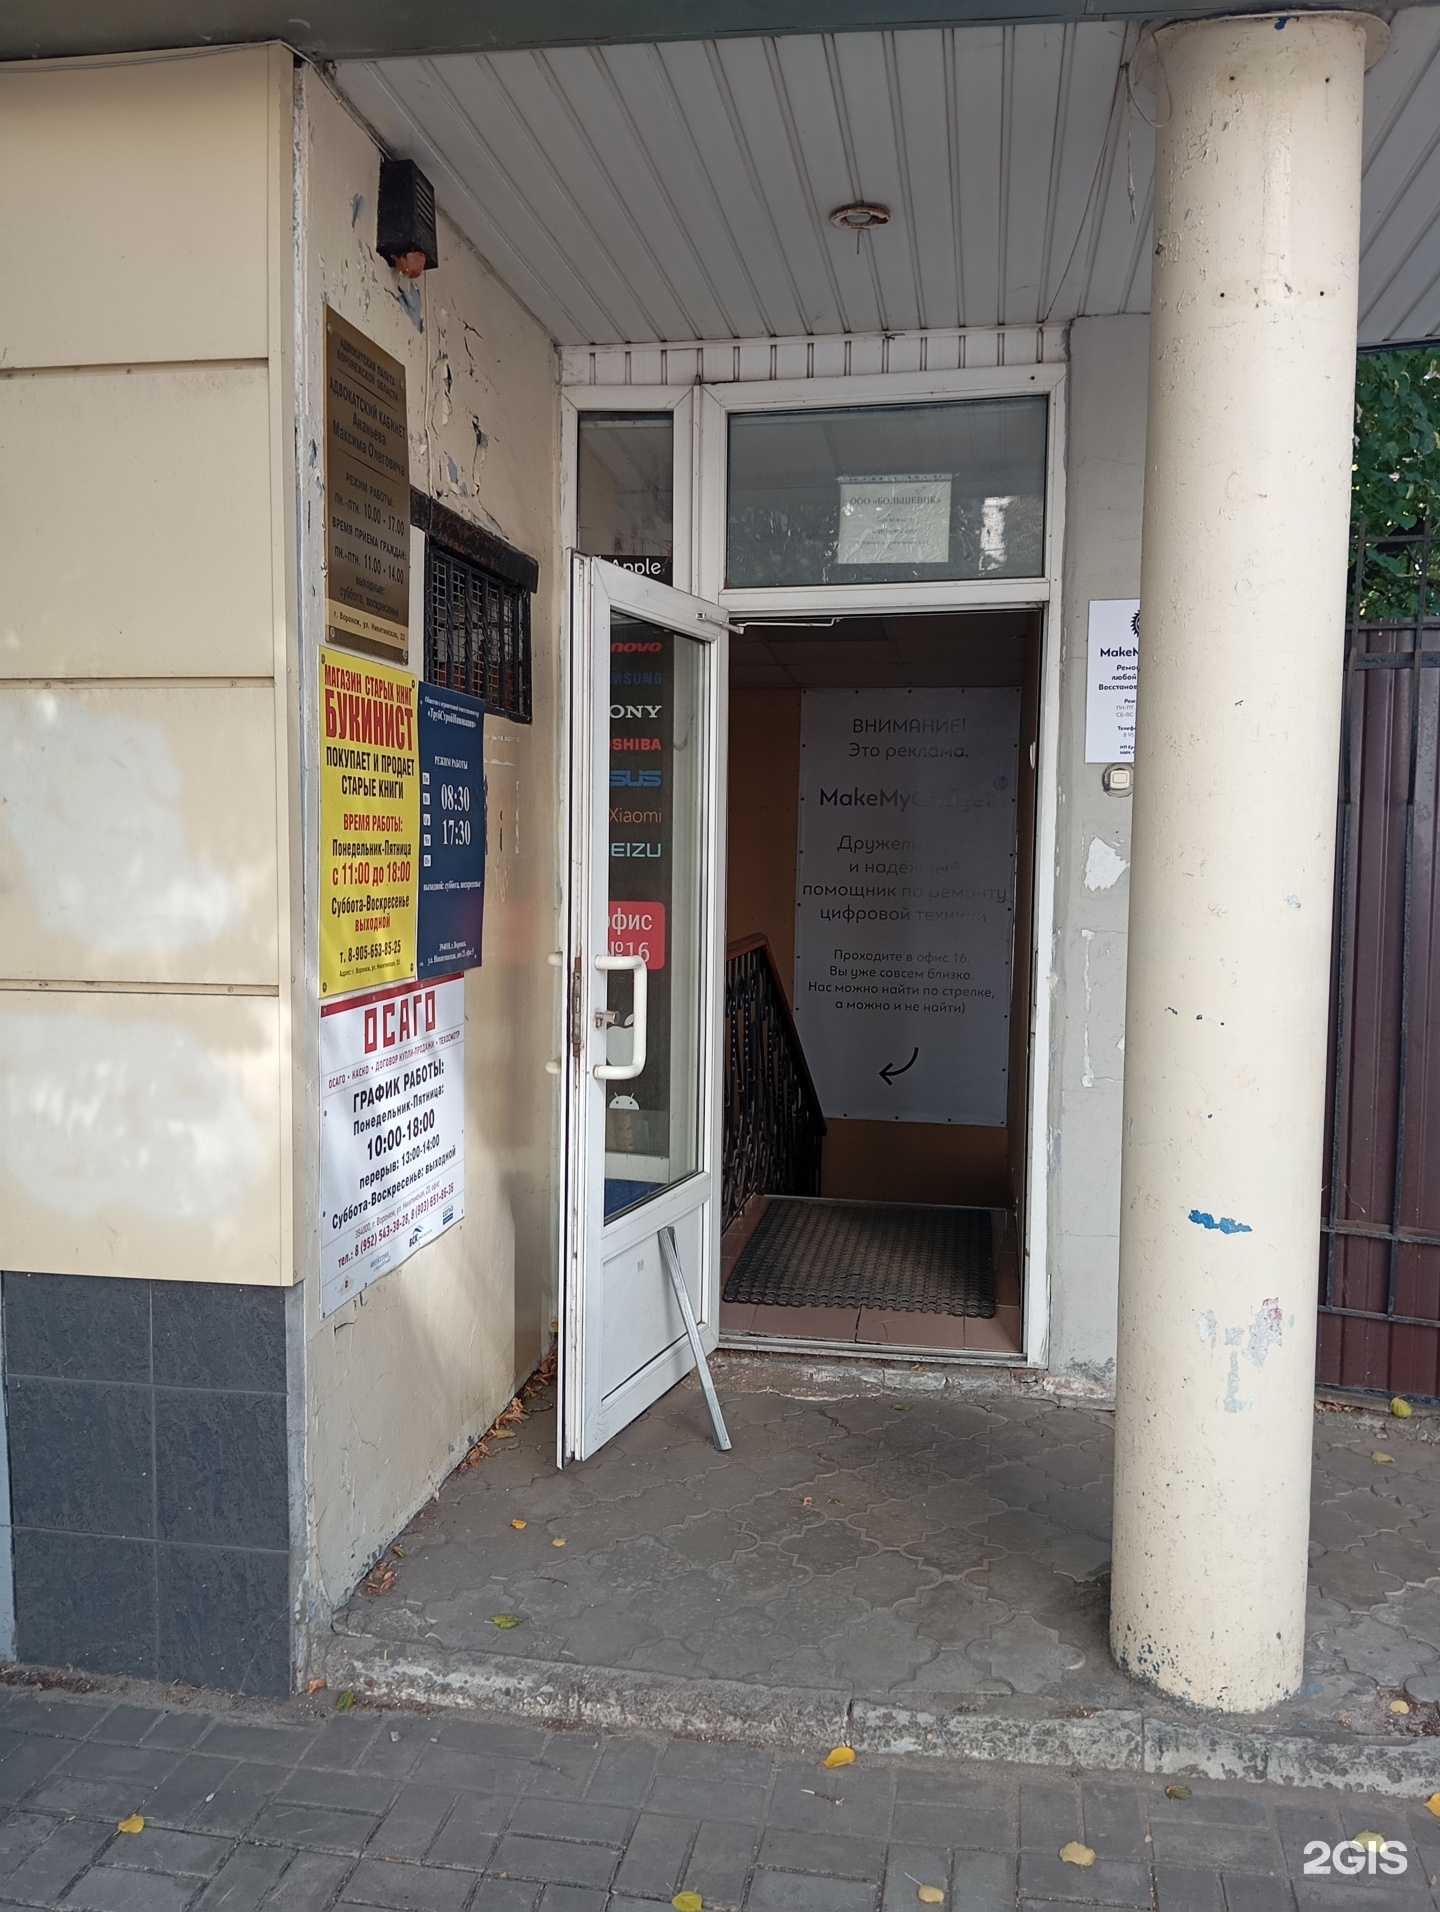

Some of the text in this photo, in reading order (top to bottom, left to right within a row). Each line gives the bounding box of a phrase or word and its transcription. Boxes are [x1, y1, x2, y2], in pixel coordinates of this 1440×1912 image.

[609, 641, 662, 654] novo
[324, 663, 362, 694] МАГАЗИН
[365, 675, 395, 702] СТАРЫХ
[396, 684, 412, 707] КНИГ
[610, 672, 663, 685] MSUNG
[325, 688, 414, 751] БУКИНИСТ
[609, 704, 662, 719] ONY
[852, 718, 967, 734] ВНИМАНИЕ!
[610, 738, 662, 751] SHIBA
[848, 743, 880, 758] Это
[326, 746, 415, 778] ПОКУПАЕТ И ПРОДАЕТ
[341, 775, 376, 797] СТАРЫЕ
[378, 779, 404, 800] КНИГИ
[609, 770, 663, 787] SUS
[441, 783, 470, 812] 08:30
[343, 813, 370, 831] ВРЕМЯ
[372, 814, 403, 833] РАБОТЫ:
[609, 807, 662, 824] Xiaomi
[441, 819, 471, 846] 17:30
[332, 839, 412, 858] Понедельник-Пятница
[610, 842, 662, 858] EIZU
[332, 867, 338, 886] с
[341, 862, 370, 885] 11:00
[372, 867, 384, 887] до
[386, 861, 411, 883] 18:00
[849, 862, 859, 873] и
[802, 884, 897, 899] помощник
[331, 894, 410, 918] Суббота-Воскресенье
[820, 904, 911, 924] цифровой
[354, 915, 391, 933] выходной
[608, 907, 653, 936] фис
[833, 949, 903, 963] Проходите
[906, 953, 913, 962] в
[829, 966, 848, 978] Вы
[851, 968, 877, 979] уже
[879, 969, 924, 980] совсем
[808, 982, 832, 993] Нас
[834, 984, 878, 995] можно
[881, 982, 920, 995] найти
[922, 987, 939, 996] по
[835, 1001, 966, 1014] а можно и не найти)
[364, 990, 436, 1054] ОСАГО
[328, 1073, 346, 1089] ОСАГО
[351, 1065, 369, 1080] КАСКО
[375, 1055, 399, 1072] ДОГОВОР
[353, 1058, 445, 1113] ГРАФИК РАБОТЫ:
[353, 1084, 444, 1136] Понедельник-Пятница:
[367, 1108, 435, 1161] 10:00-18:00
[359, 1133, 440, 1190] перерыв: 13:00-14:00
[332, 1144, 457, 1231] Суббота-Воскресенье: выходной
[338, 1252, 353, 1268] тел.:
[360, 1234, 377, 1256] (952)
